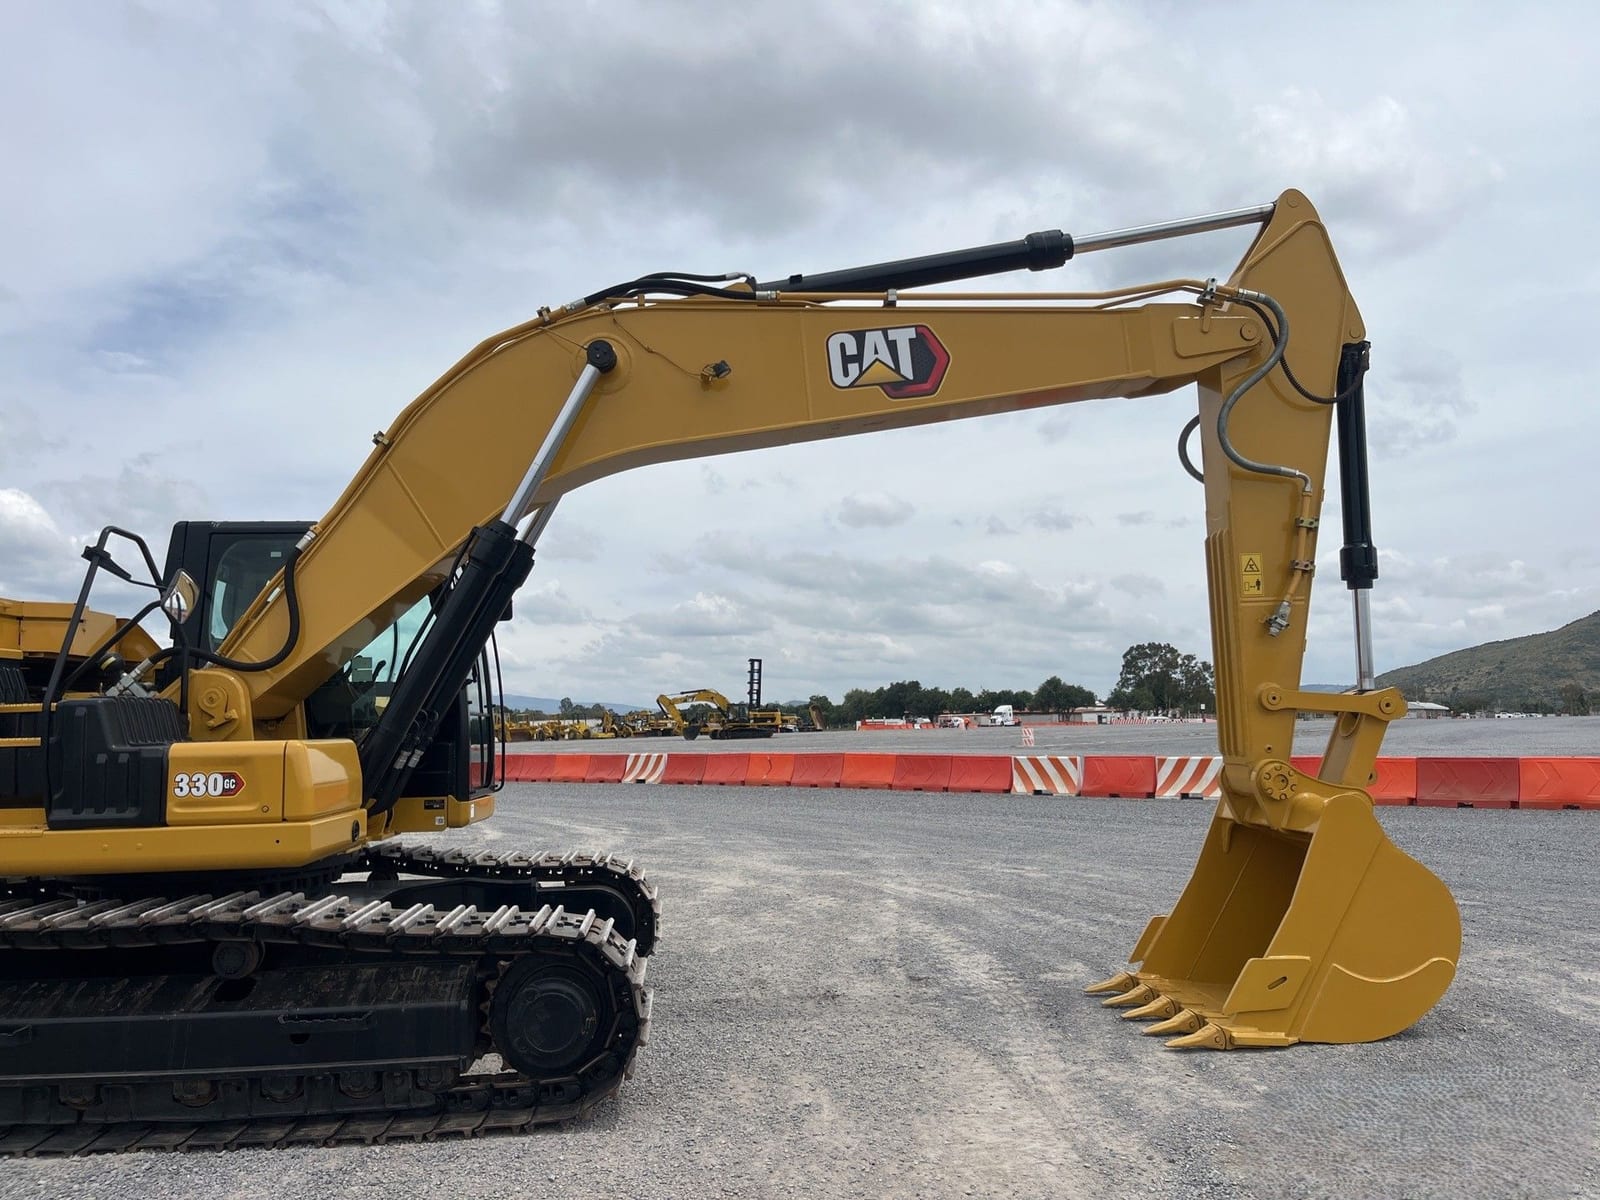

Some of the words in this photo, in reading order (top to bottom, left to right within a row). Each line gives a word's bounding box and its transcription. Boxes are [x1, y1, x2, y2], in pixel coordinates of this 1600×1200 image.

[827, 327, 917, 387] CAT
[174, 773, 224, 797] 330
[224, 779, 236, 789] GC
